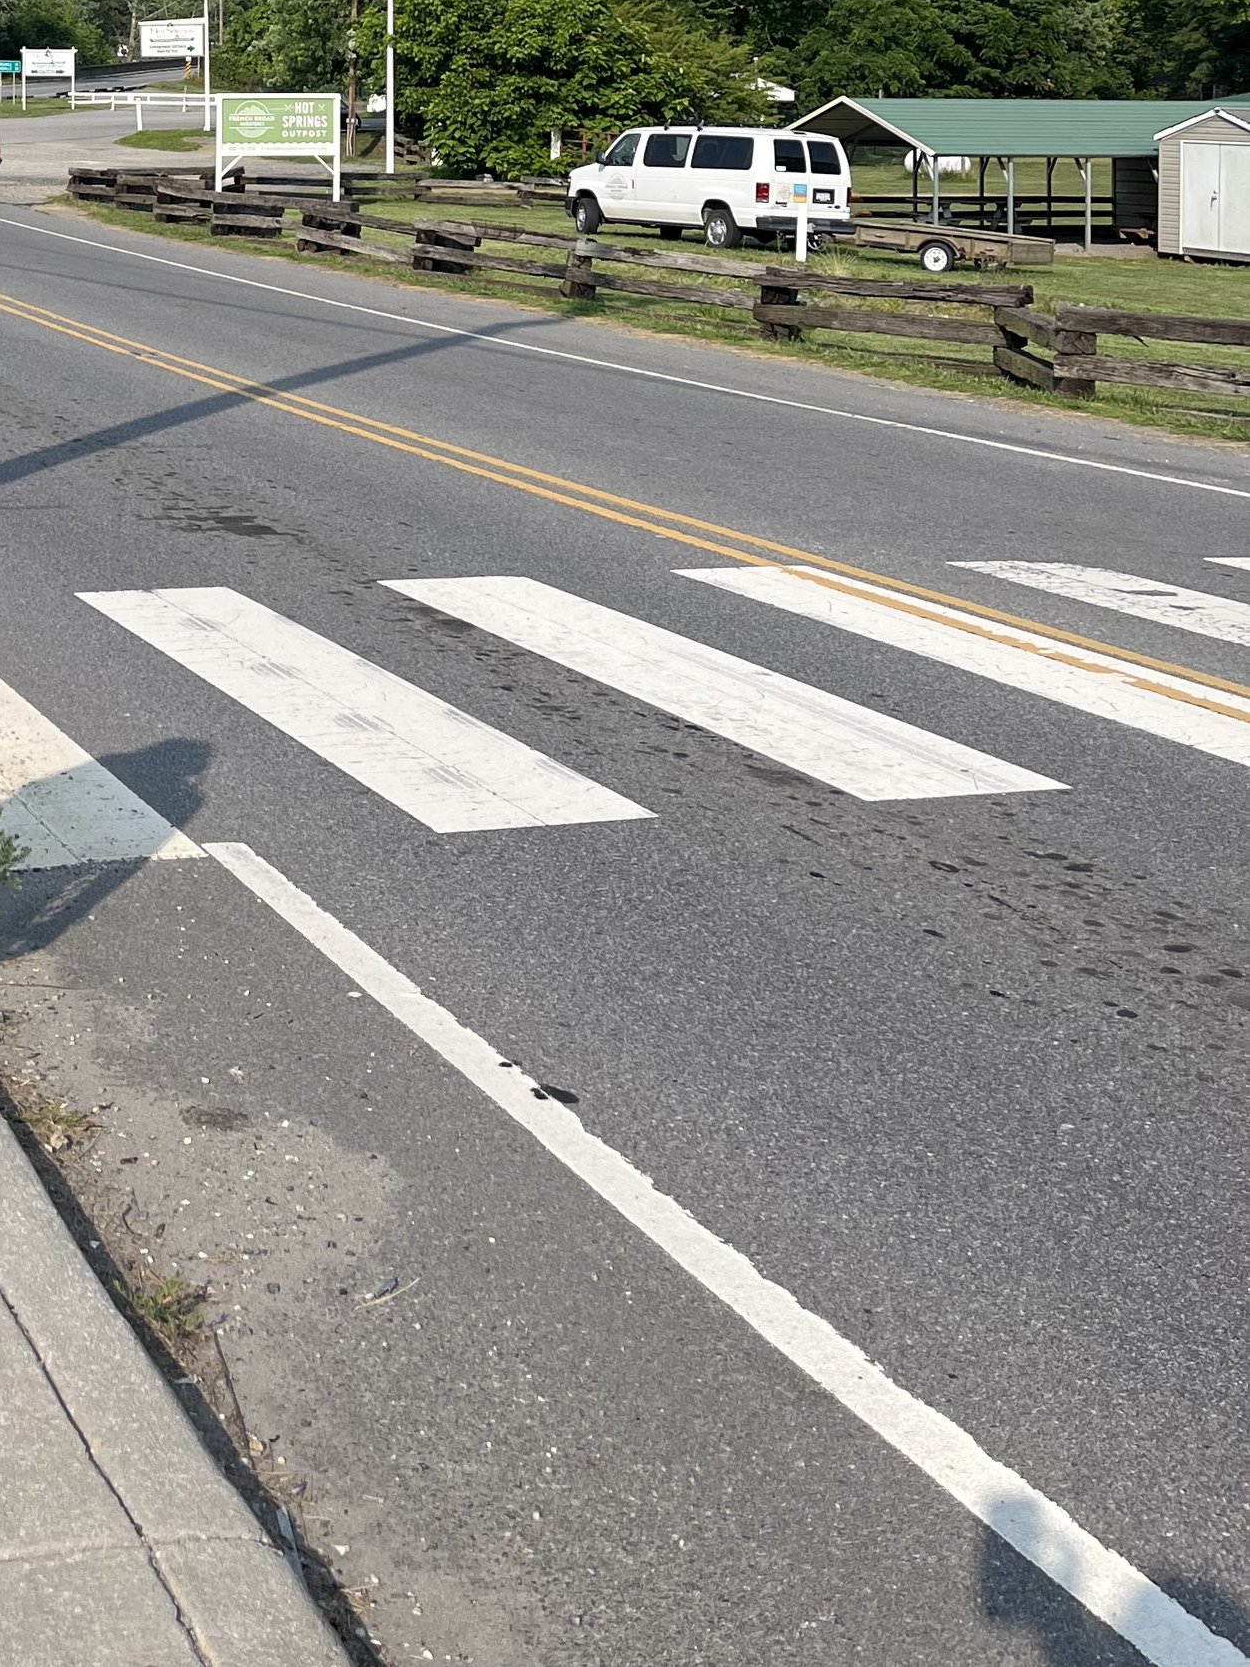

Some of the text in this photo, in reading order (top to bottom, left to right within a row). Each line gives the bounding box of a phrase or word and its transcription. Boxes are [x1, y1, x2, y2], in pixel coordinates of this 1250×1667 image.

[294, 102, 314, 114] HOT
[282, 115, 328, 128] SPRINGS
[281, 130, 328, 138] OUTPOST
